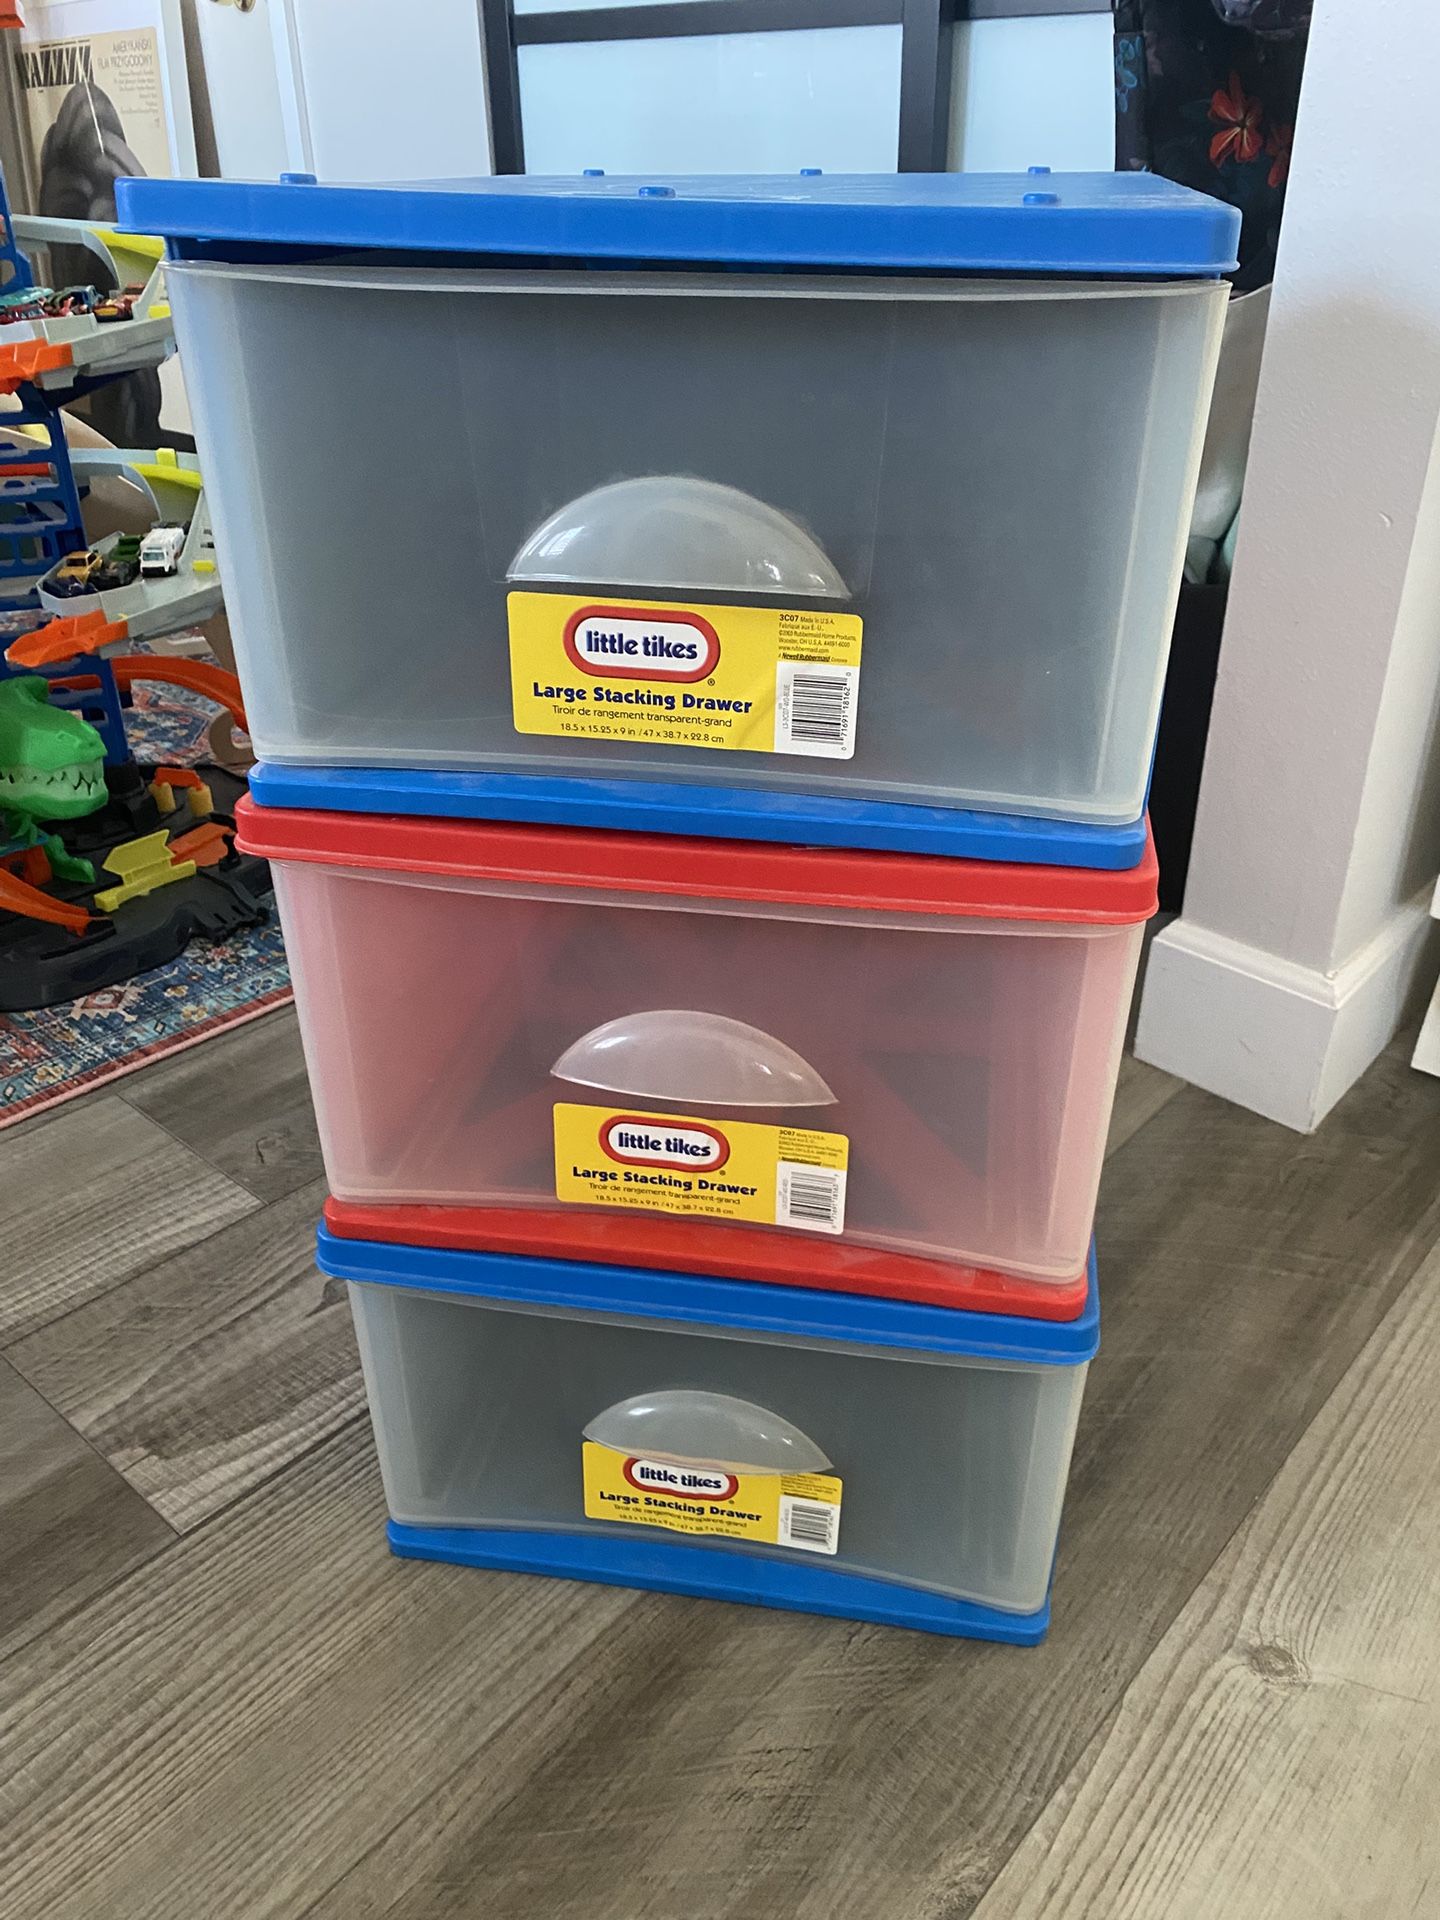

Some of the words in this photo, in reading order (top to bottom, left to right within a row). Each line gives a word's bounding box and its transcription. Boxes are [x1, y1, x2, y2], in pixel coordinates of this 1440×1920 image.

[779, 614, 799, 622] 3C07
[586, 630, 638, 656] little
[642, 635, 698, 660] tikes
[533, 682, 587, 703] Large
[594, 686, 676, 710] Stacking
[682, 694, 752, 714] Drawer
[552, 704, 576, 715] Tiroir
[578, 707, 591, 716] de
[594, 709, 644, 720] rangement
[647, 713, 732, 728] transparent-grand
[561, 722, 578, 732] 18.5
[588, 724, 610, 734] 15.25
[621, 726, 626, 734] 9
[628, 727, 636, 736] in
[643, 728, 653, 738] 47
[663, 730, 682, 740] 38.7
[690, 732, 710, 742] 22.8
[711, 736, 724, 744] cm
[618, 1132, 662, 1152] little
[665, 1138, 711, 1157] tikes
[572, 1166, 618, 1182] Large
[624, 1172, 692, 1191] Stacking
[698, 1180, 758, 1196] Drawer
[589, 1182, 608, 1190] Tiroir
[623, 1187, 666, 1196] rangement
[640, 1467, 678, 1484] little
[681, 1474, 722, 1489] tikes
[600, 1491, 640, 1504] Large
[644, 1497, 704, 1516] Stacking
[710, 1506, 762, 1521] Drawer
